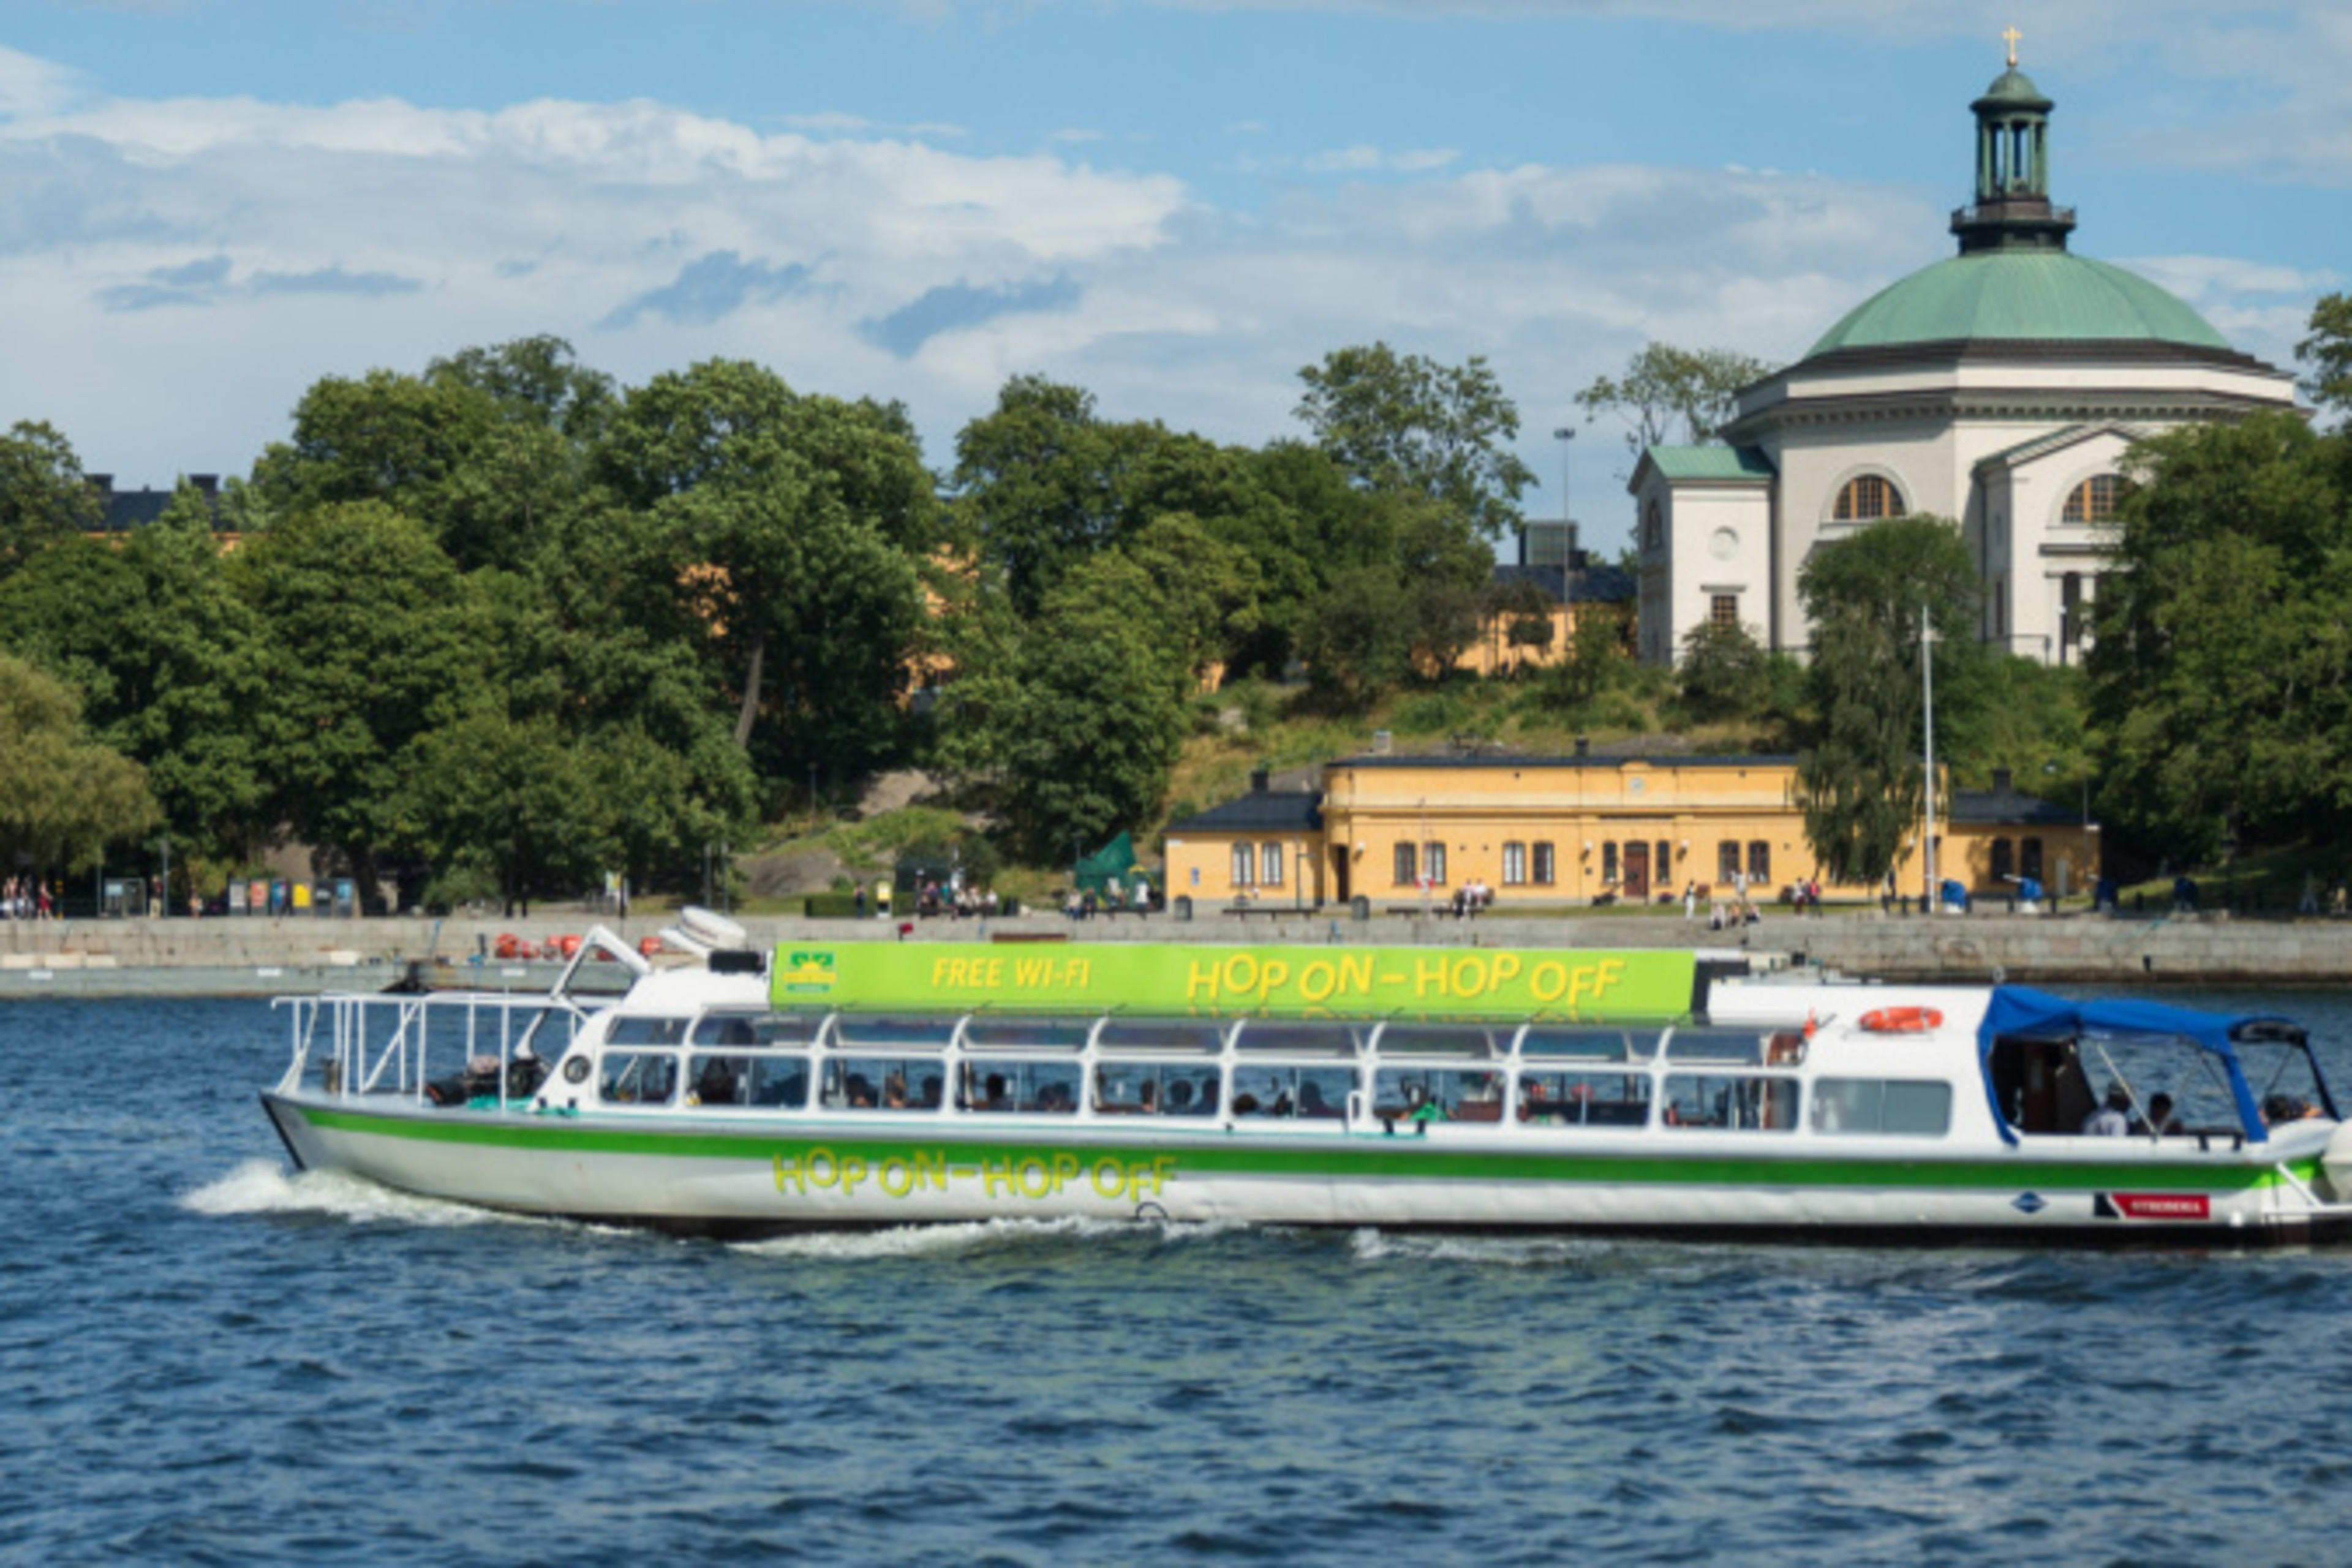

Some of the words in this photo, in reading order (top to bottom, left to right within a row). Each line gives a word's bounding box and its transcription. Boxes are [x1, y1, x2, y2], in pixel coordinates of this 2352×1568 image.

[931, 957, 1005, 988] FREE
[1015, 957, 1091, 989] WI-FI
[1186, 952, 1289, 1000] HOP
[1415, 952, 1521, 998] HOP
[1529, 958, 1626, 1006] OFF
[774, 1147, 867, 1195] HOP
[982, 1153, 1079, 1199] HOP
[1091, 1156, 1177, 1202] OFF
